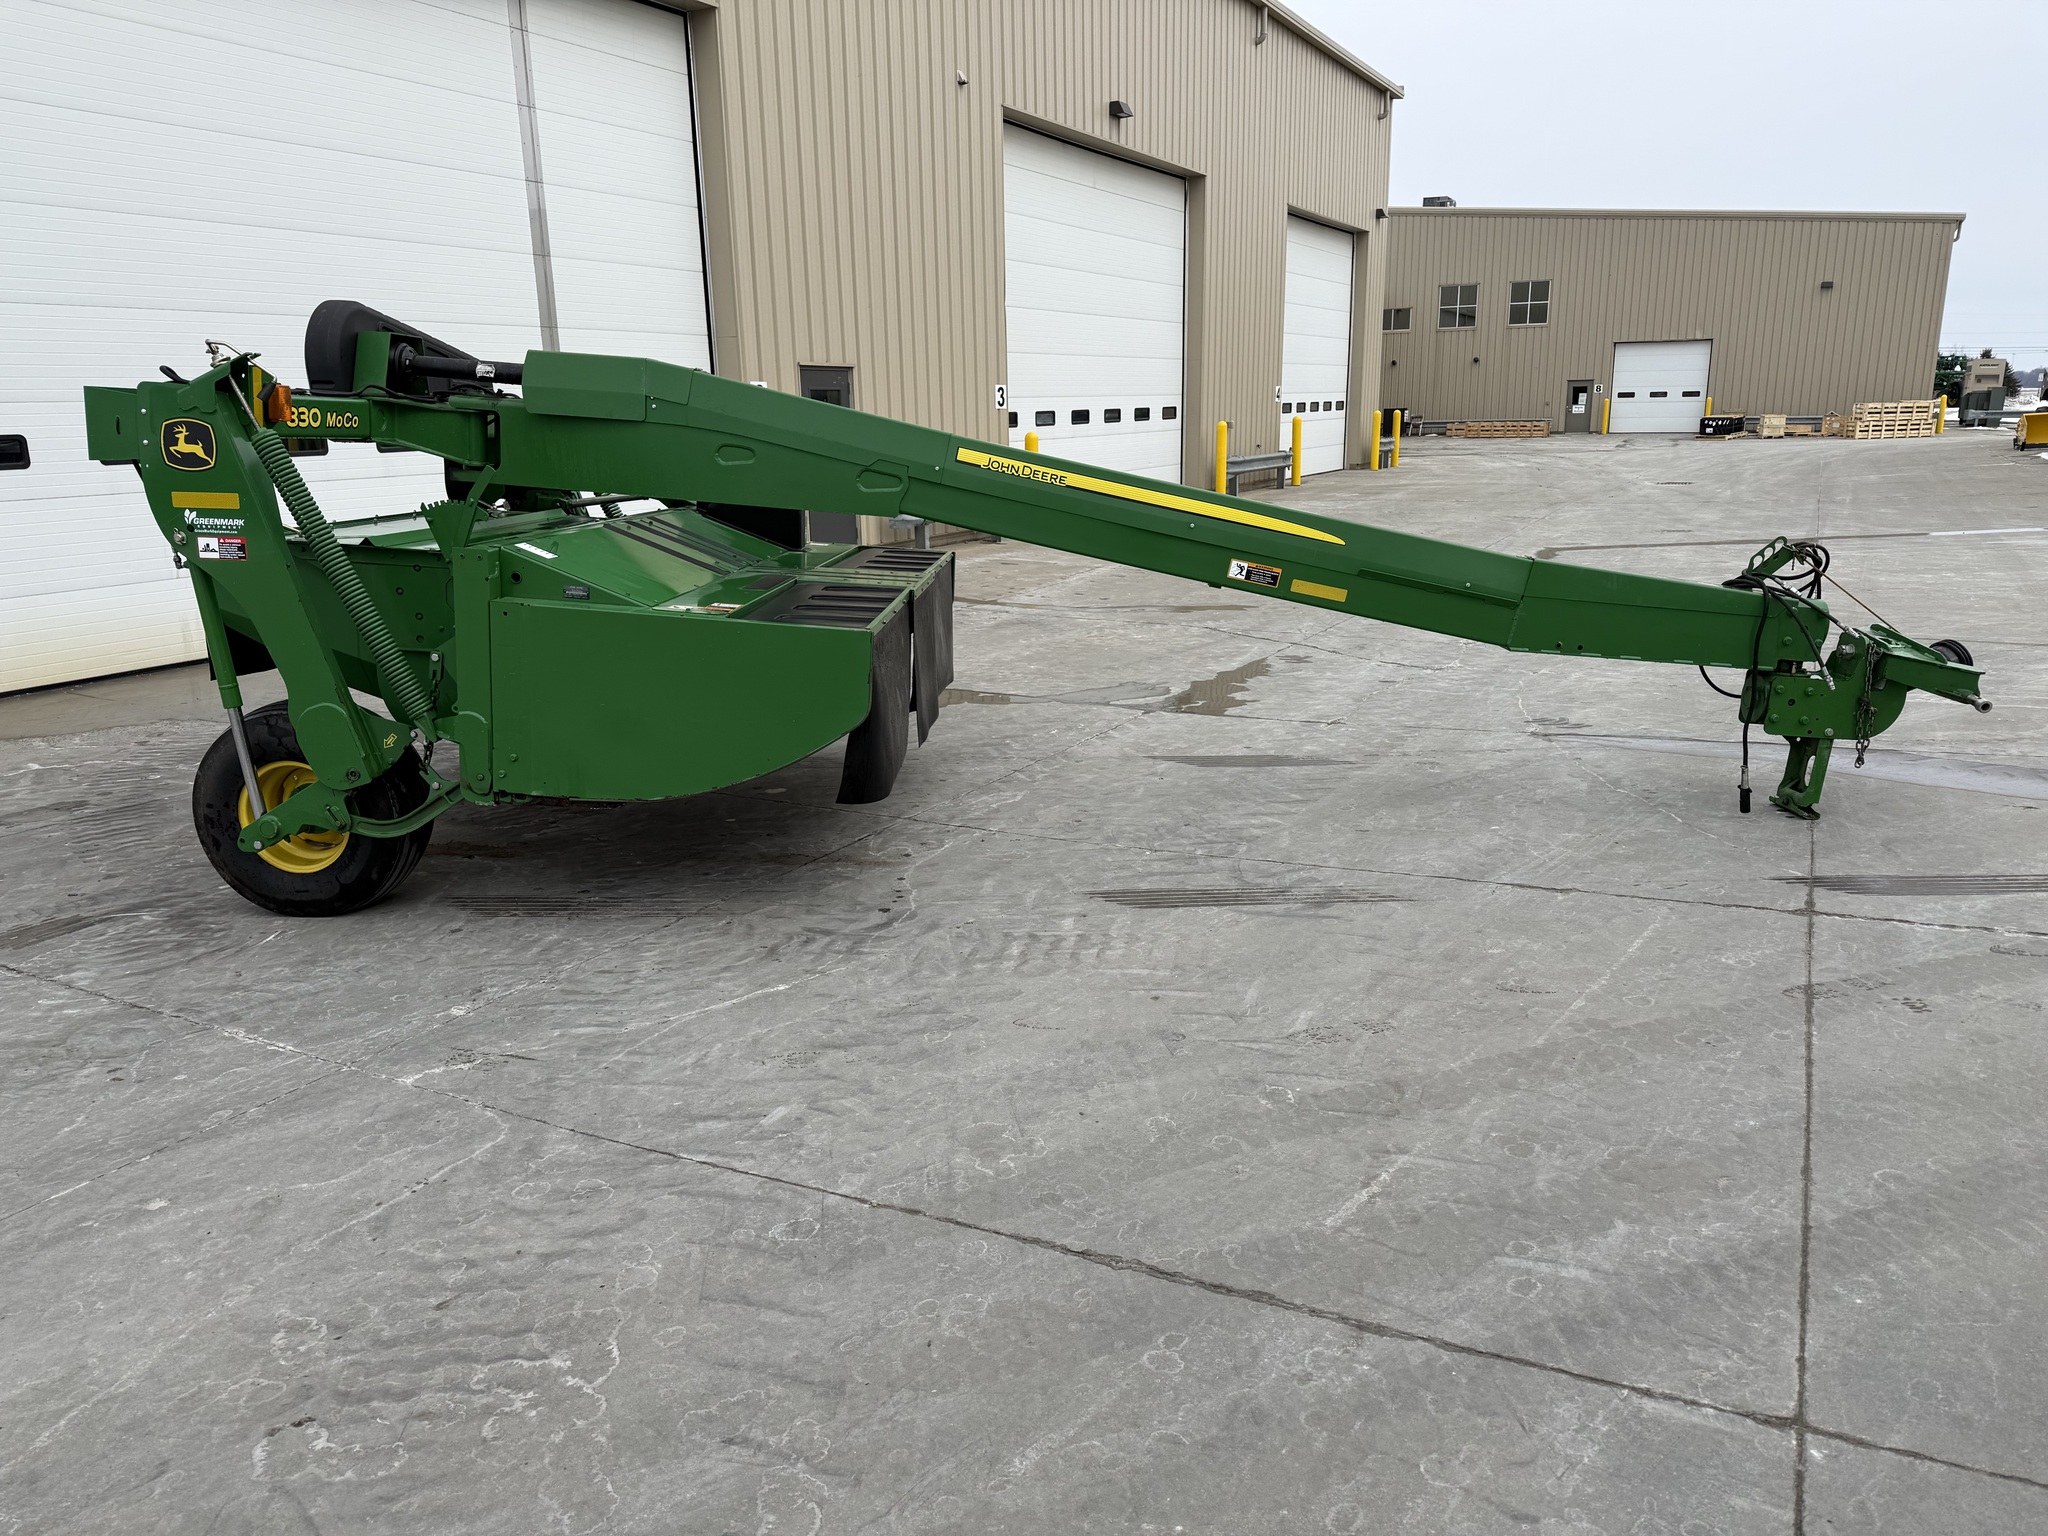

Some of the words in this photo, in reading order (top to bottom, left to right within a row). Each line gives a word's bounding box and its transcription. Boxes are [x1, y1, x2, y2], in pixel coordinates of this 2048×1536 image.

[997, 386, 1005, 407] 3
[326, 412, 359, 428] MoCo
[982, 457, 1020, 476] JOHN
[1021, 465, 1068, 485] DEERE
[193, 517, 245, 526] GREENMARK
